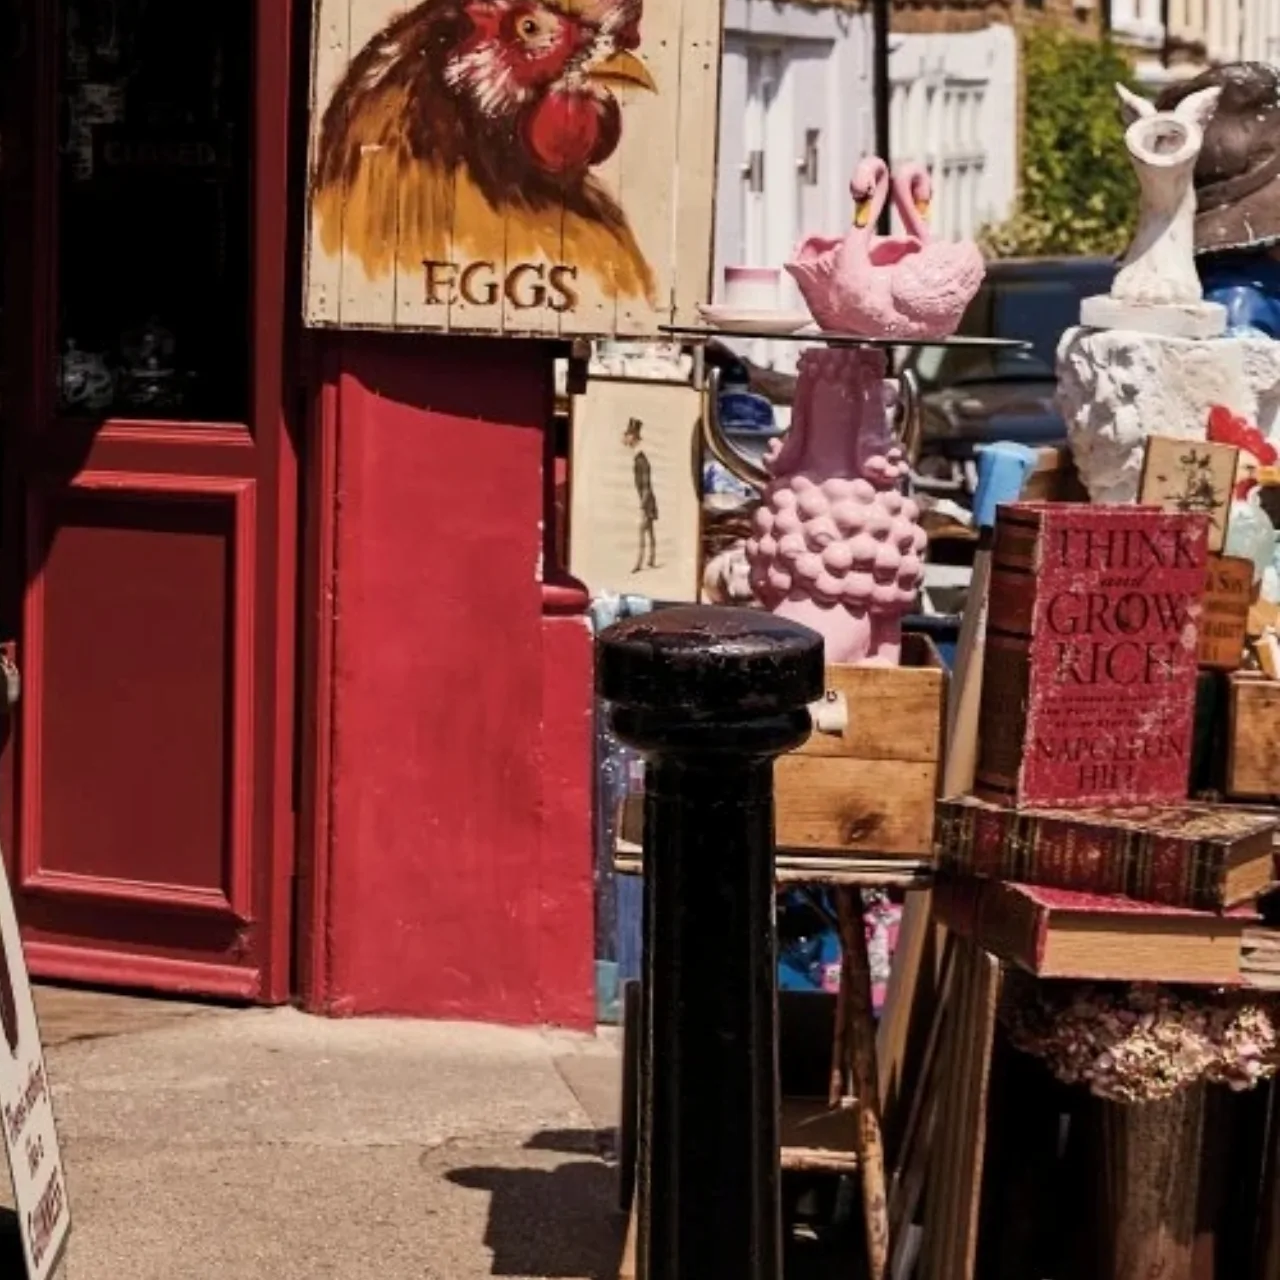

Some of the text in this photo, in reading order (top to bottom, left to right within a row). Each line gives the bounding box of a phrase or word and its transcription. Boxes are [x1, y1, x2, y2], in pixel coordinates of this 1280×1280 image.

[421, 260, 578, 313] EGGS
[1054, 528, 1199, 570] THINK
[1100, 563, 1154, 588] and
[1047, 591, 1194, 636] GROW
[1054, 641, 1179, 687] RICH
